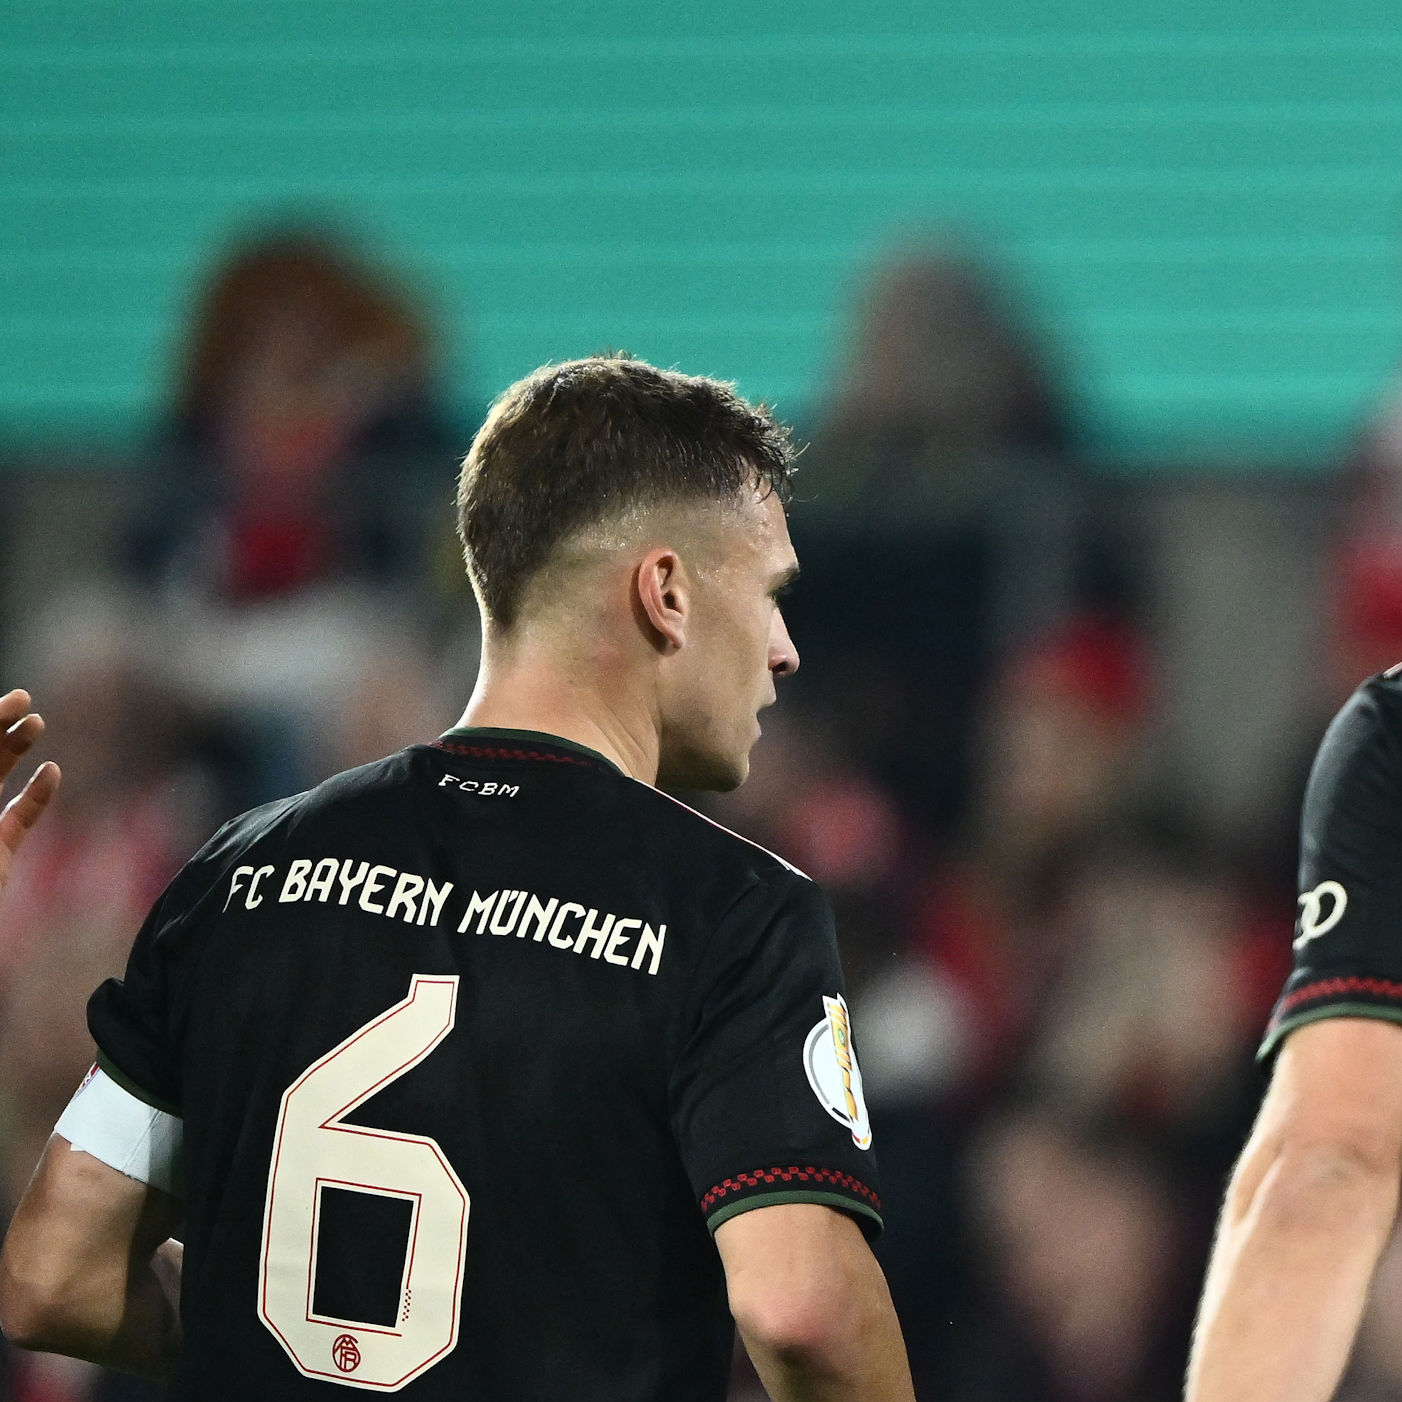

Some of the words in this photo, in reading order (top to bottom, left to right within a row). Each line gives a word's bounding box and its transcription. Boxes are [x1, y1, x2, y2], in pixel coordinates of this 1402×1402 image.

[438, 774, 520, 798] FCBM
[222, 864, 275, 914] FC
[278, 857, 455, 927] BAYERN
[456, 888, 667, 976] MÜNCHEN
[256, 973, 471, 1393] 6
